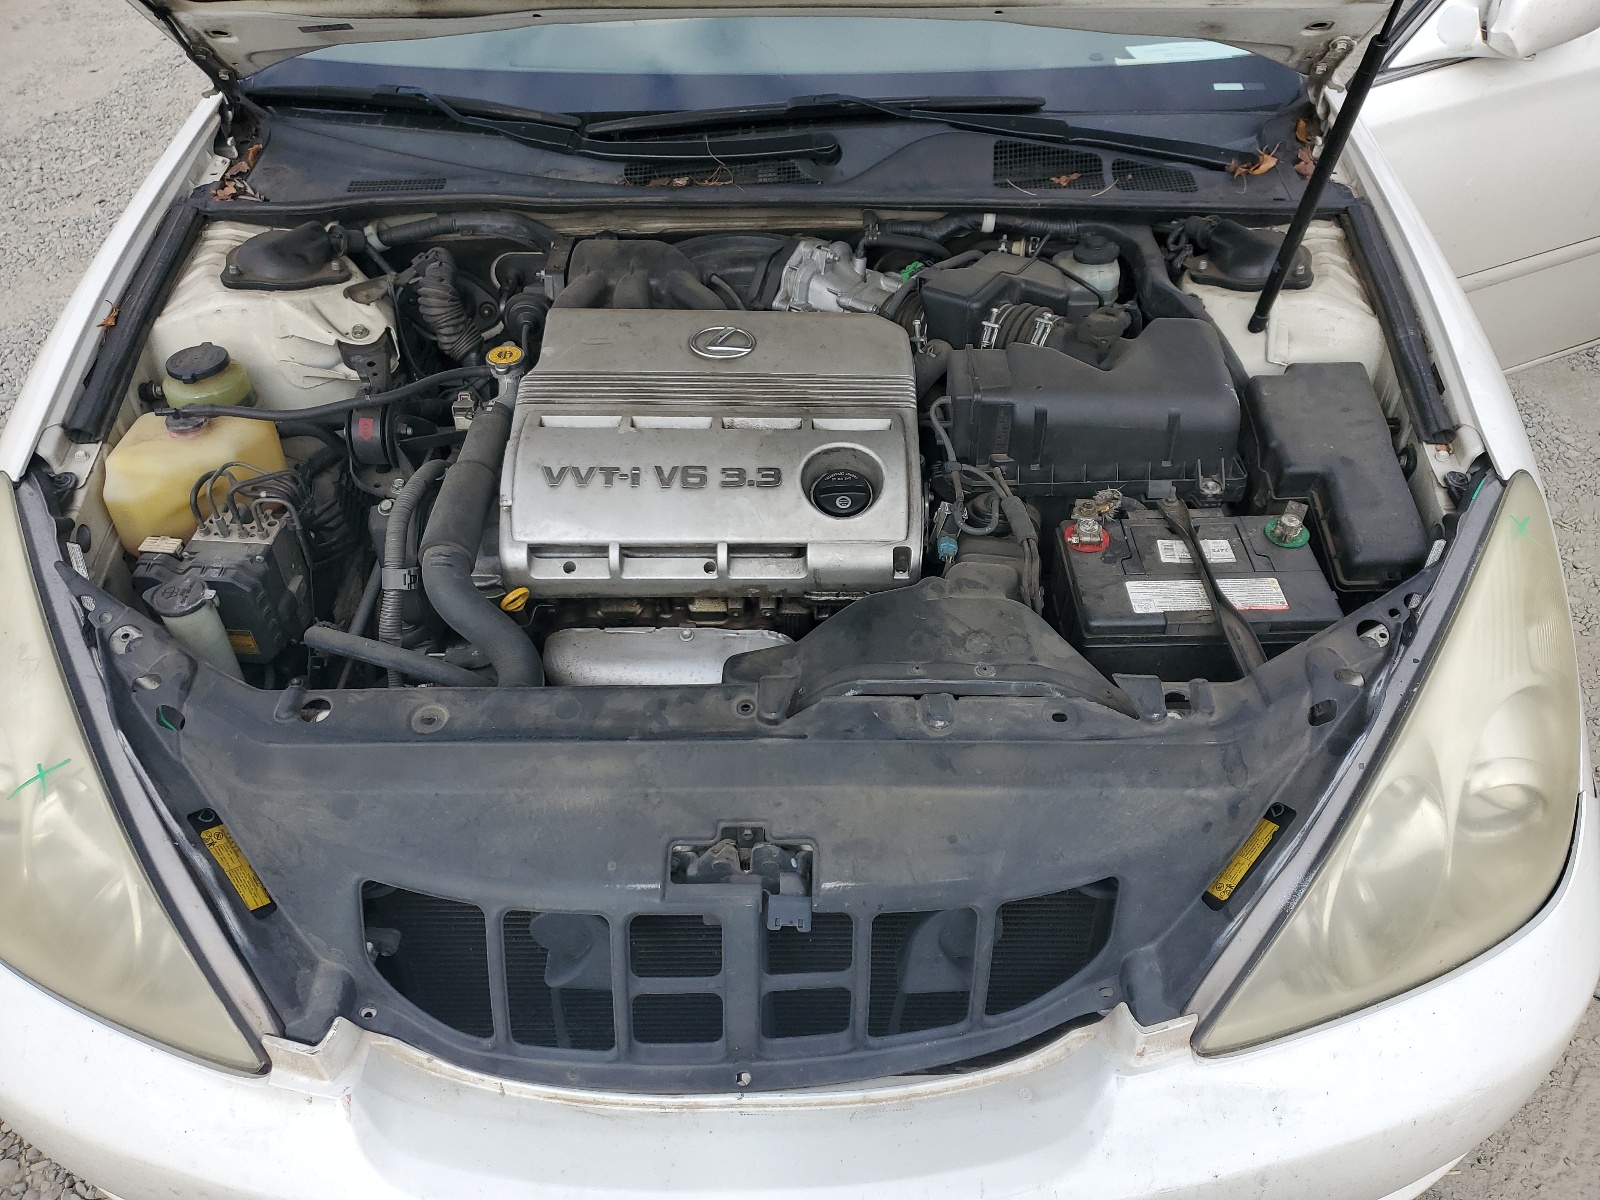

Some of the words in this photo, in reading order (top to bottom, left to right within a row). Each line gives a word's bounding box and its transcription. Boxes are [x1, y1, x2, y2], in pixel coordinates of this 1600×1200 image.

[542, 465, 641, 488] VVT-i
[653, 465, 708, 489] V6
[720, 467, 783, 488] 3.3
